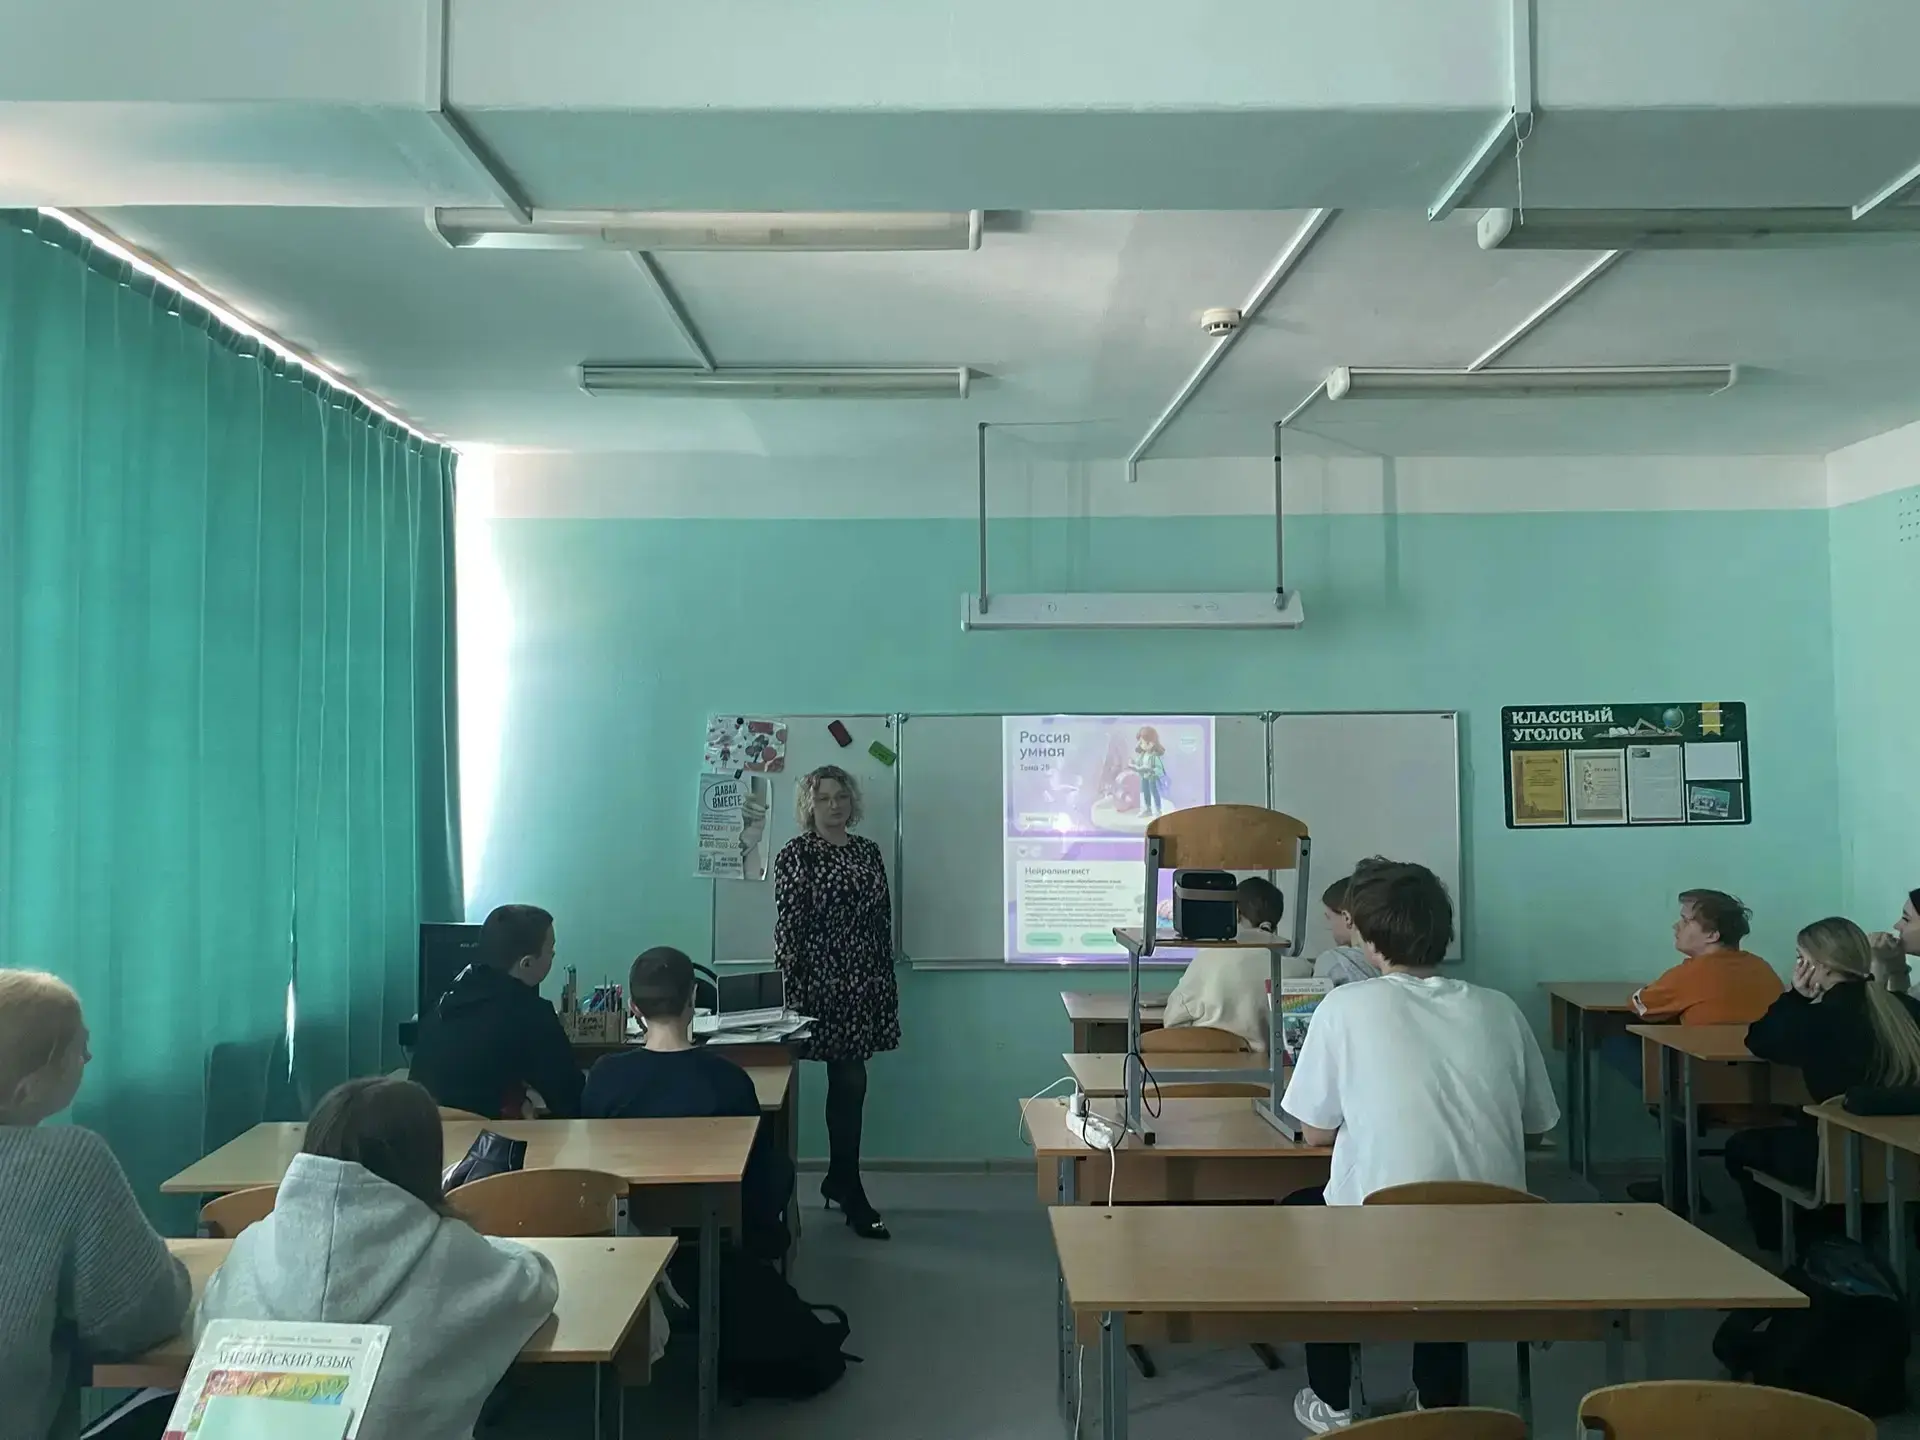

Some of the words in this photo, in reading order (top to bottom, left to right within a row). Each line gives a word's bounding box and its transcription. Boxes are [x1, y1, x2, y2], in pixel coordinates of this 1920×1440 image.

[1511, 706, 1614, 724] КЛАССНЫЙ
[1020, 730, 1071, 743] Россия
[1512, 727, 1584, 742] УГОЛОК
[1020, 747, 1065, 760] умная
[714, 783, 738, 797] ДАВАЙ
[712, 794, 742, 809] ВМЕСТЕ
[1025, 866, 1090, 876] Нейролингвист
[219, 1350, 313, 1368] АНГЛИЙСКИЙ
[313, 1354, 356, 1370] ЯЗЫК
